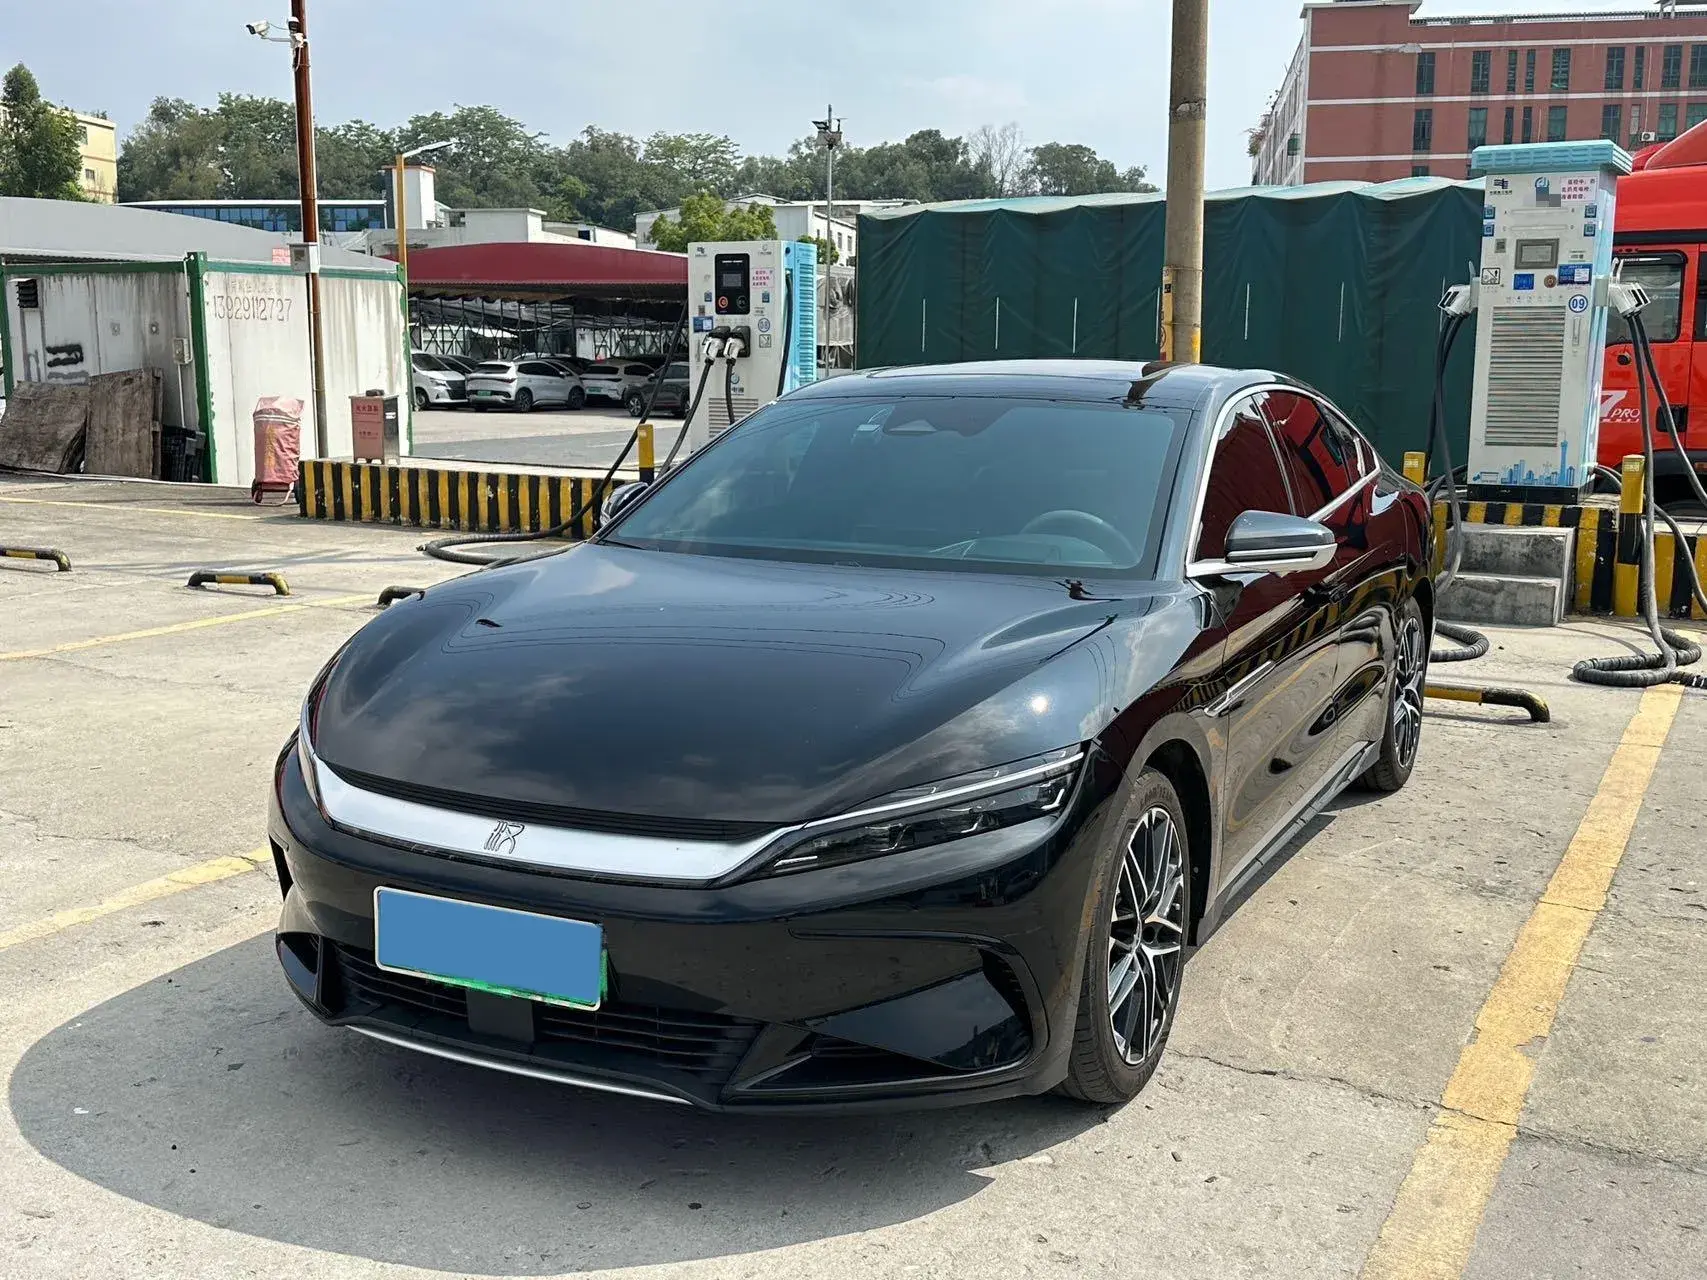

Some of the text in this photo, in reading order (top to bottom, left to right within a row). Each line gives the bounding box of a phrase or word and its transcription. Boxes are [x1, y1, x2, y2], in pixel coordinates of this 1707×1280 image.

[1572, 298, 1585, 309] 09
[1600, 390, 1628, 418] 7
[1611, 408, 1640, 418] PRO
